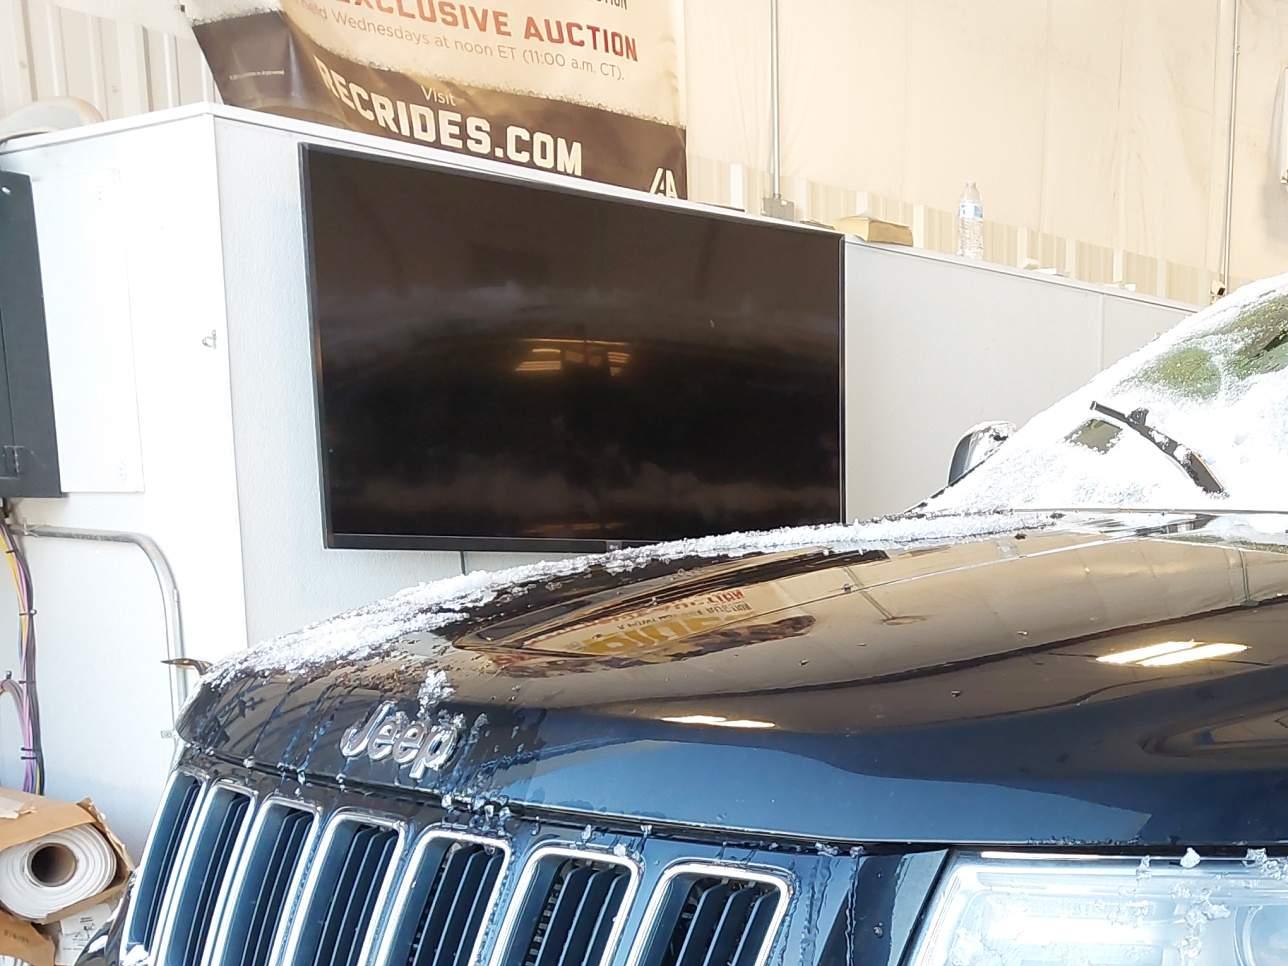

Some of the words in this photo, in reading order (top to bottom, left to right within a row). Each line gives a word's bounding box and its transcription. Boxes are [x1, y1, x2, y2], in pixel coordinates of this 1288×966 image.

[332, 8, 431, 45] Wednesdays
[434, 35, 450, 49] at
[454, 40, 494, 56] noon
[497, 45, 516, 60] ET
[522, 49, 566, 67] (11:00
[600, 62, 625, 81] CT).
[336, 0, 511, 37] CLUSIVE
[524, 16, 638, 62] AUCTION
[313, 55, 582, 176] RECRIDES.COM
[421, 85, 457, 107] Visit
[340, 700, 458, 780] Jeep
